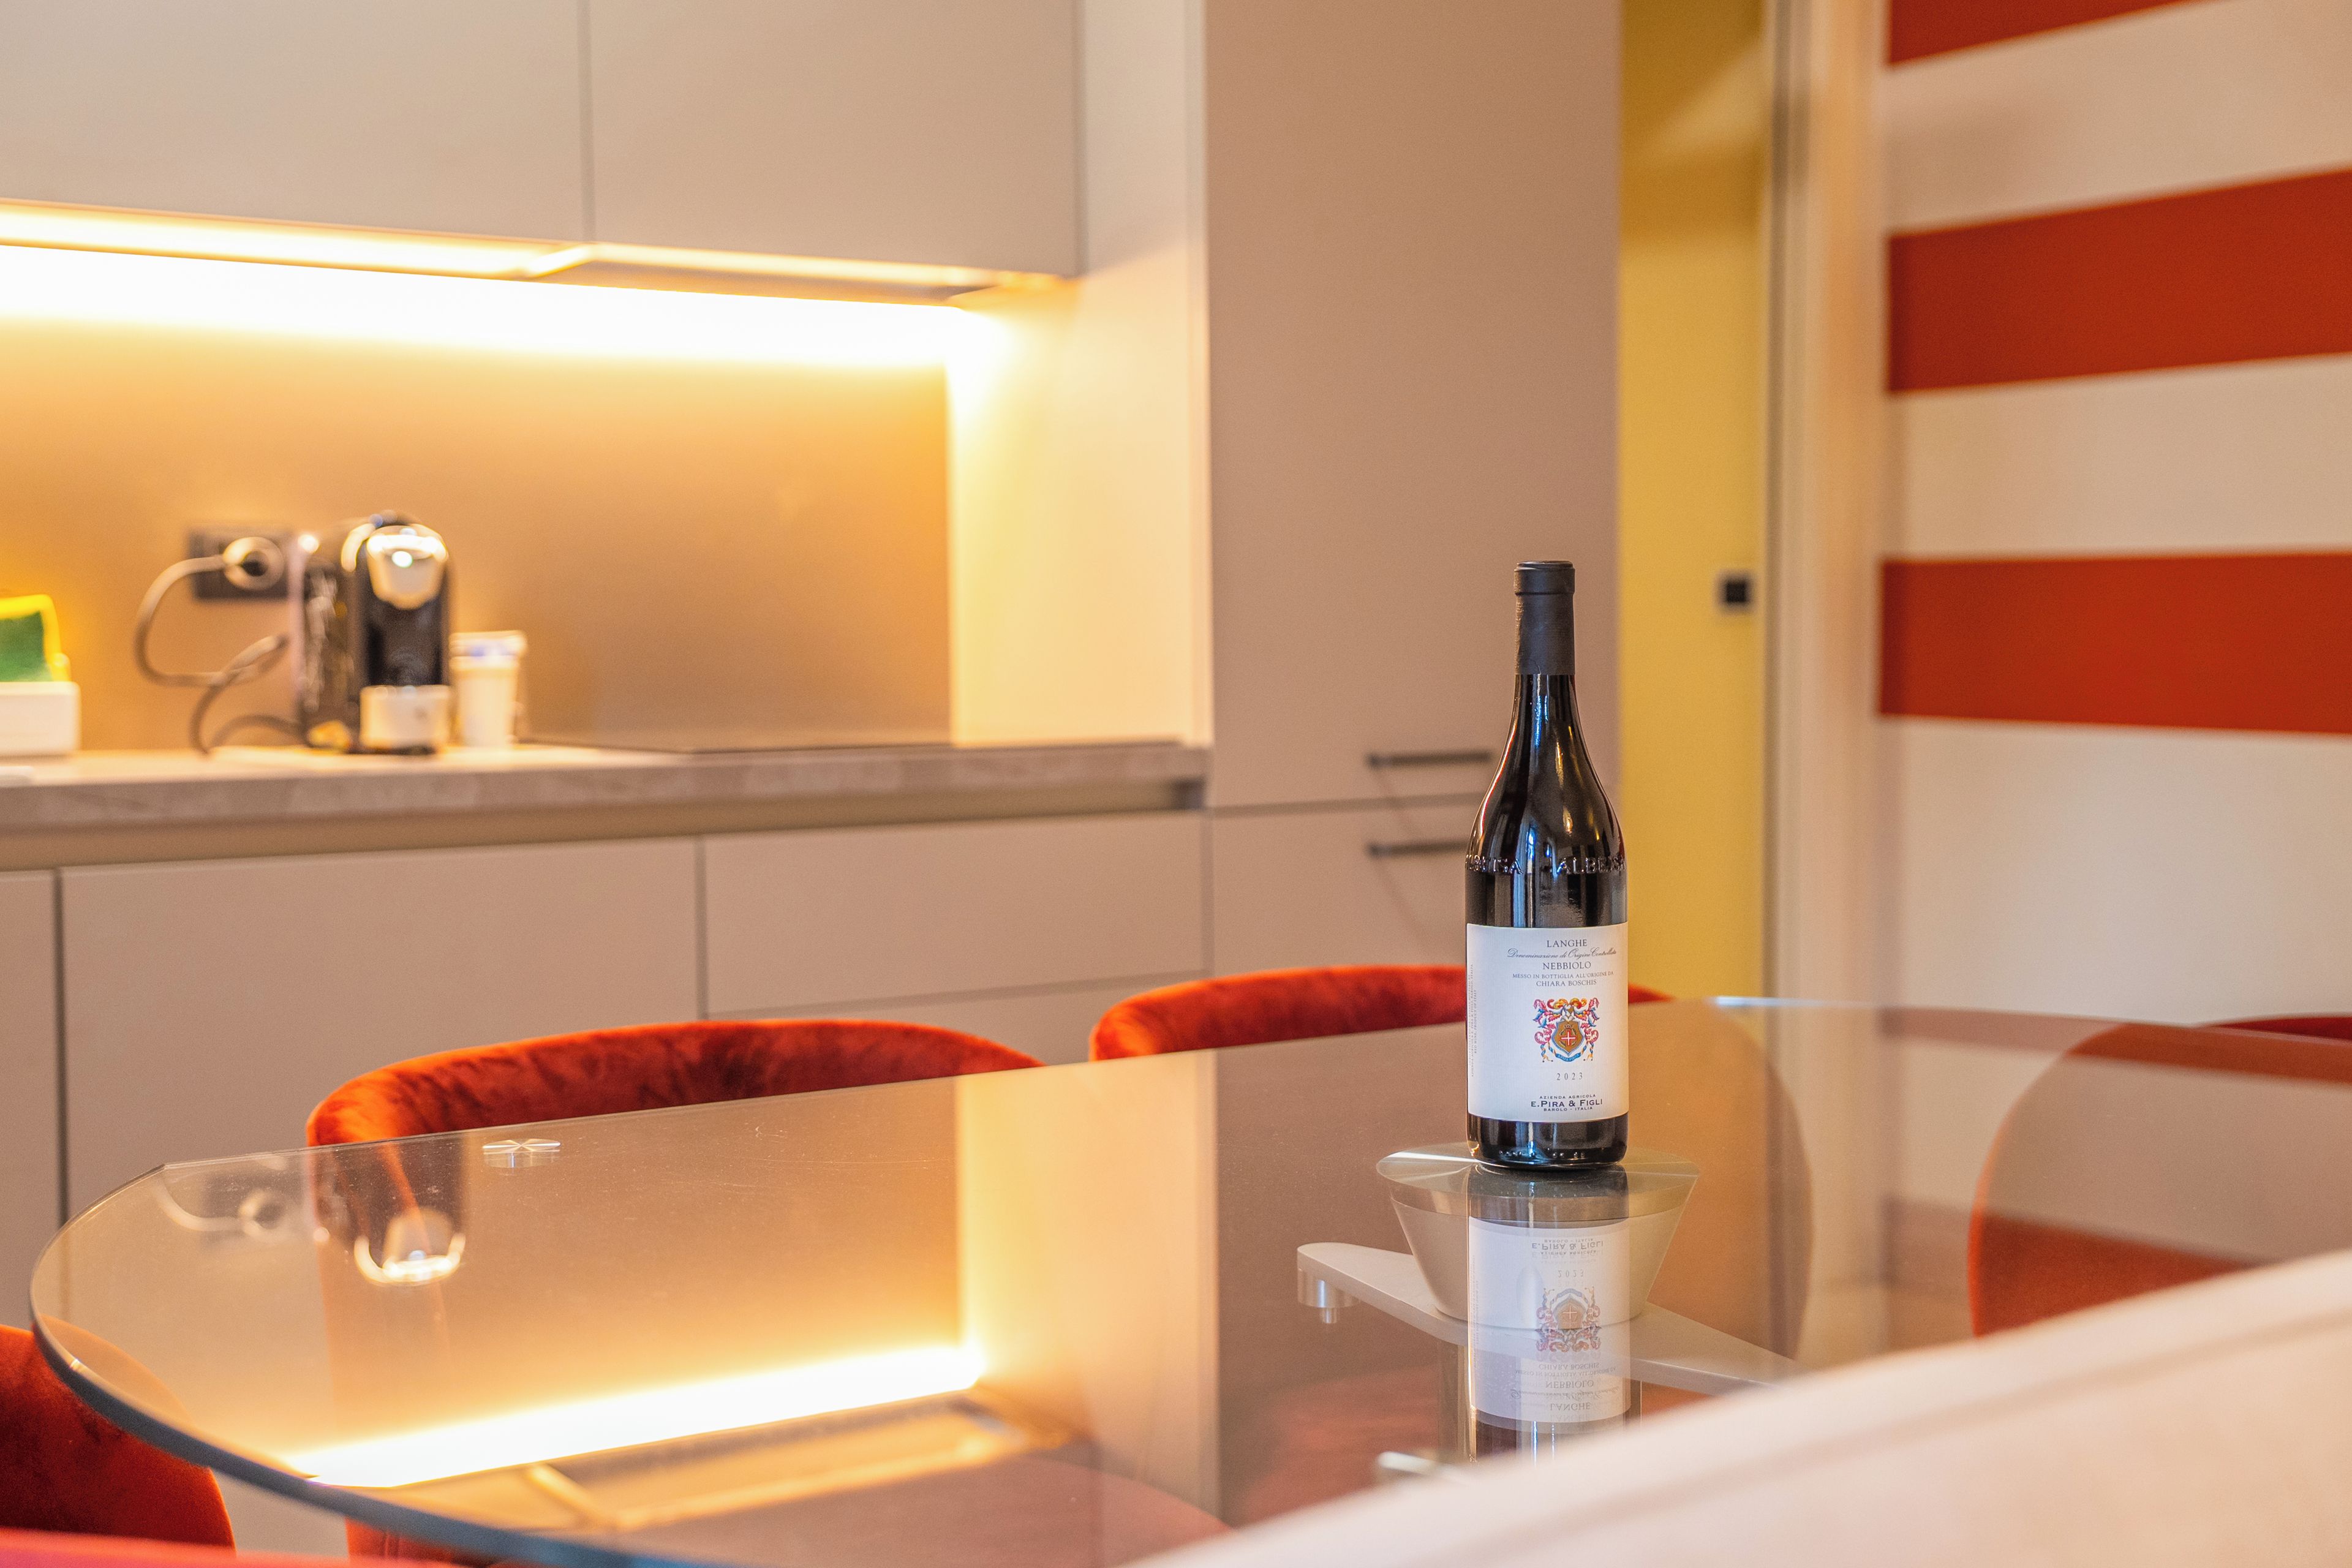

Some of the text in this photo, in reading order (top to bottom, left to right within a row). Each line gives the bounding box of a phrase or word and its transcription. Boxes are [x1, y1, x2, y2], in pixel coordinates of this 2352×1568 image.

[1547, 939, 1588, 948] LANGHE
[1507, 948, 1558, 958] Denominazione
[1568, 948, 1591, 960] Origine
[1543, 961, 1591, 970] NEBBIOLO
[1556, 1072, 1583, 1080] 2023
